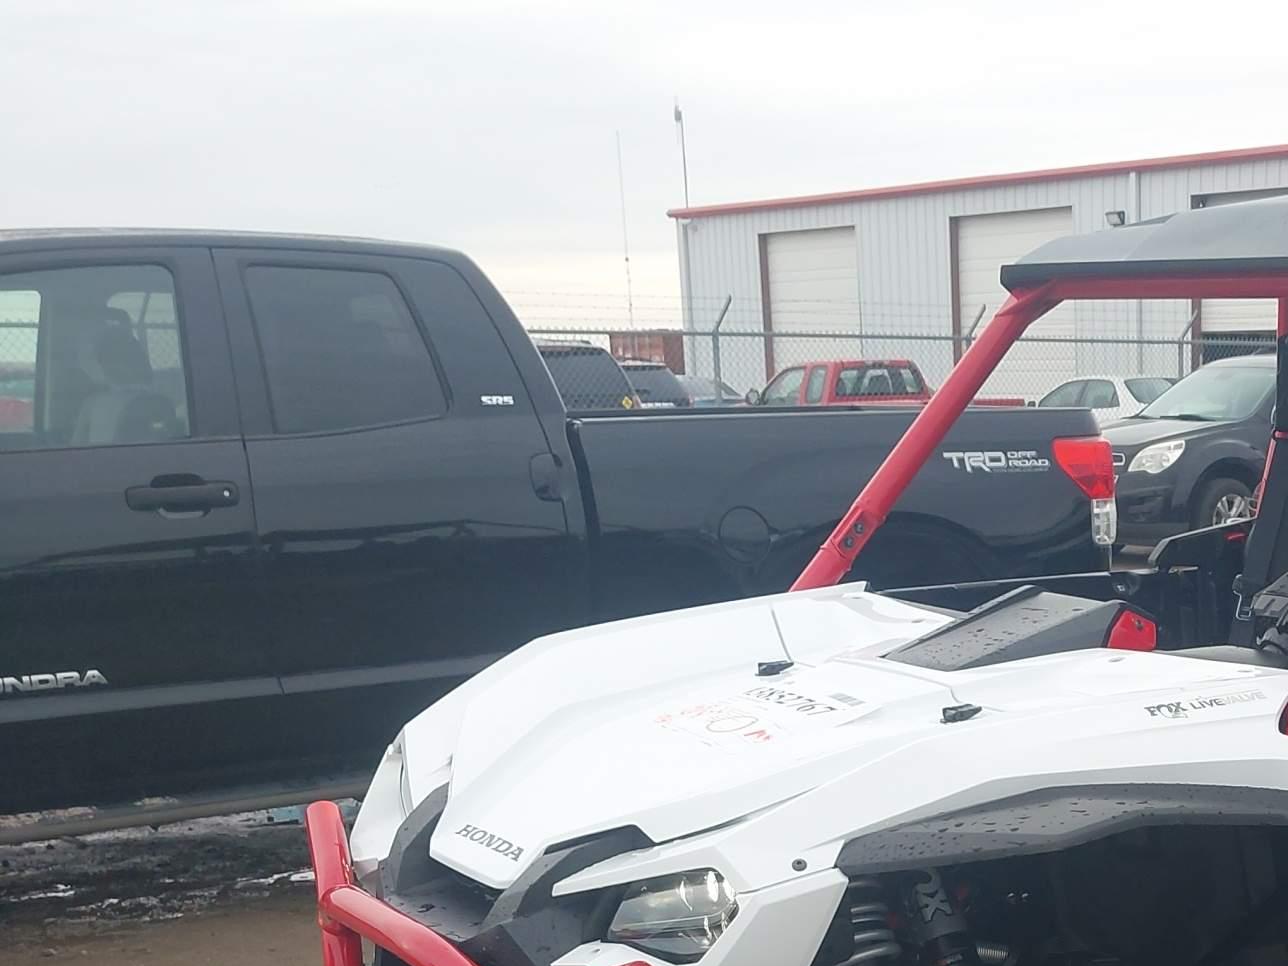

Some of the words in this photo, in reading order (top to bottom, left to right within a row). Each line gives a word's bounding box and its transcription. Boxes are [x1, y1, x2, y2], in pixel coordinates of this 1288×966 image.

[480, 395, 515, 406] SR5
[942, 451, 1006, 473] TRD
[1006, 450, 1038, 459] OFF
[1008, 458, 1050, 467] ROAD
[0, 670, 109, 693] NDRA
[1144, 701, 1189, 718] FOX
[455, 823, 525, 862] HONDA
